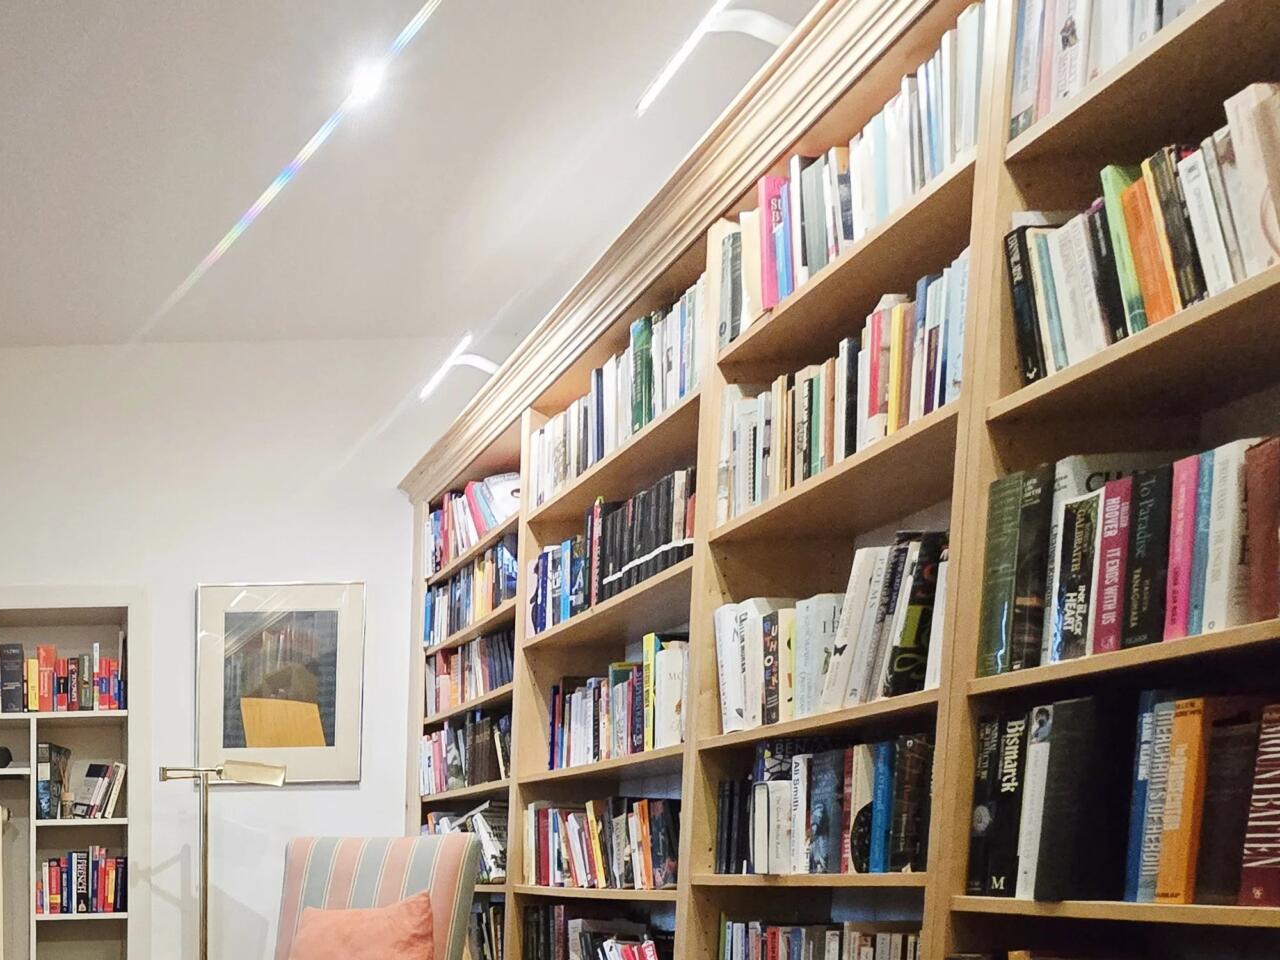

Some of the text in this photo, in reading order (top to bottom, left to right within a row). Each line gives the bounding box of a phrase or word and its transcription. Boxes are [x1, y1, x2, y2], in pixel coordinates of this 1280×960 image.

[1071, 508, 1086, 573] GALBRAITH
[1103, 496, 1121, 538] HOOVER
[1135, 476, 1157, 559] To Paradise
[869, 557, 885, 609] POEMS
[1101, 547, 1121, 626] IT ENDS WITH US
[1063, 592, 1078, 632] HEART
[1076, 585, 1088, 636] INK BLACK
[1000, 719, 1026, 793] Bismarck
[791, 778, 800, 812] Smith
[1141, 708, 1176, 877] MERCHANTS OF HEROIN
[77, 859, 87, 894] FRENCH
[991, 876, 1006, 890] M
